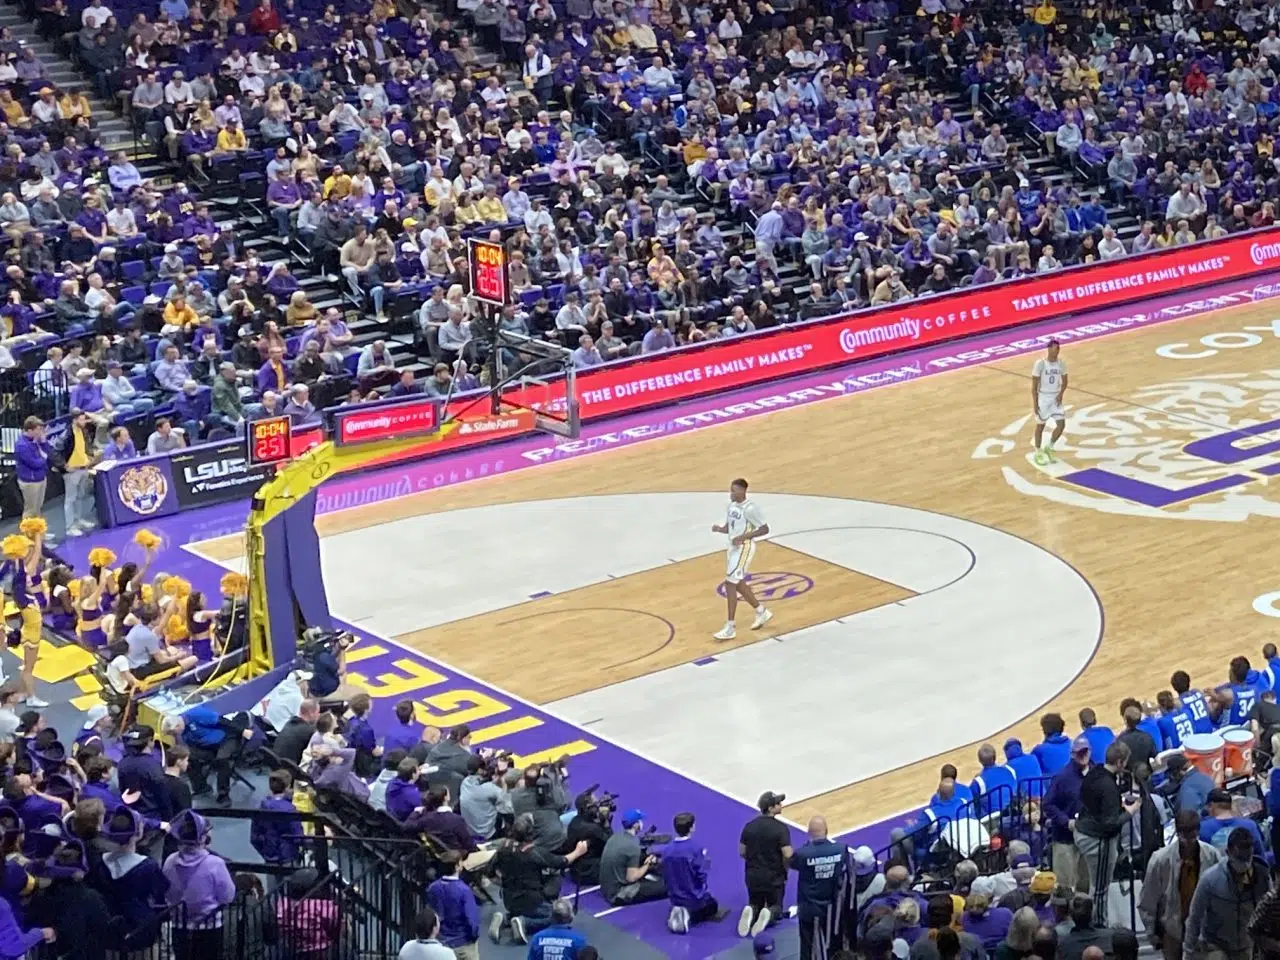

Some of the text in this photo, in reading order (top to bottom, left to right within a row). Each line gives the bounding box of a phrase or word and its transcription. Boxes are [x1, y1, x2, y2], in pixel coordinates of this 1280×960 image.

[582, 385, 613, 403] THE
[614, 367, 702, 398] DIFFERENCE
[704, 355, 755, 379] FAMILY
[838, 316, 921, 354] Community
[923, 305, 992, 331] COFFEE
[1012, 292, 1048, 313] TASTE
[1049, 286, 1075, 303] THE
[1076, 271, 1145, 298] DIFFERENCE
[1146, 264, 1186, 285] FAMILY
[1048, 375, 1056, 385] 0
[184, 459, 230, 484] LSU
[1189, 699, 1208, 721] 12
[1176, 720, 1194, 742] 23
